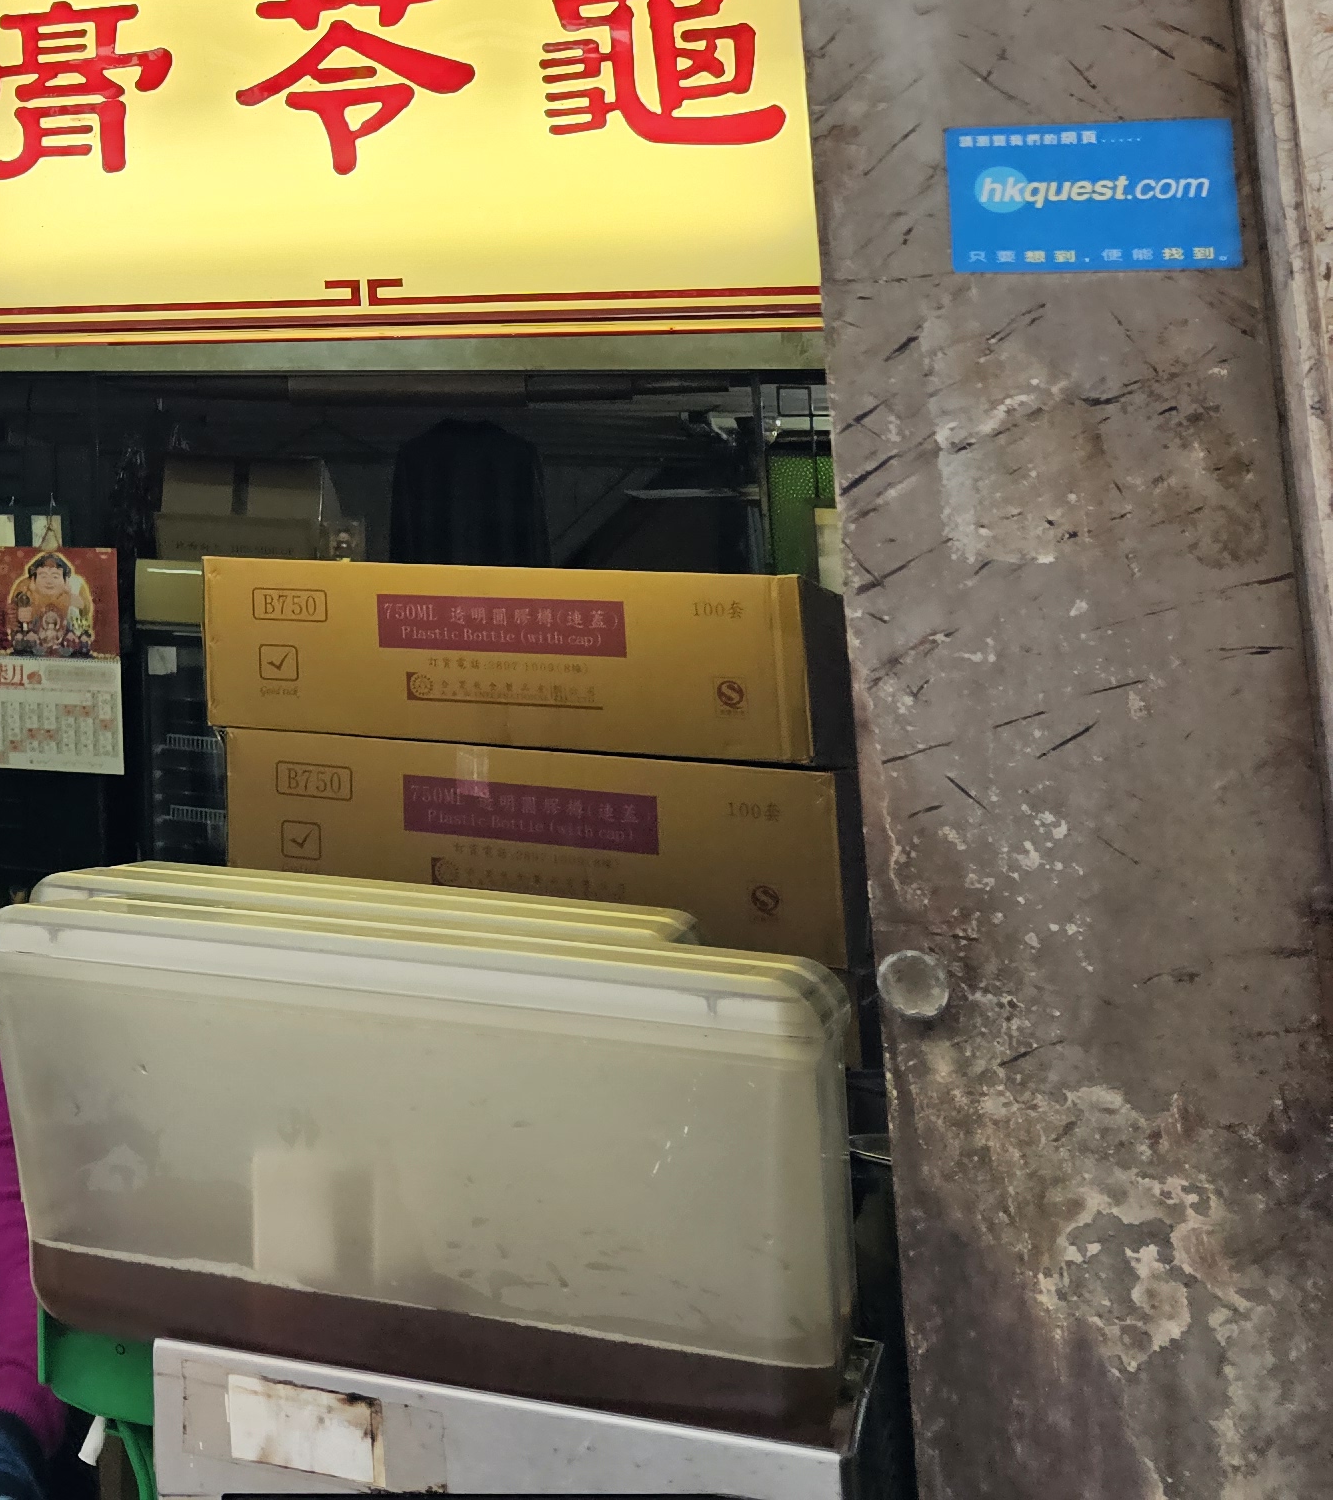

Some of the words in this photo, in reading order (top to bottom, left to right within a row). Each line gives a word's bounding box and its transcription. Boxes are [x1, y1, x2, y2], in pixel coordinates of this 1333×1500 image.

[980, 175, 1210, 208] hkquest.com
[262, 593, 318, 617] B750
[383, 602, 437, 622] 750ML
[692, 600, 744, 620] 100套
[400, 625, 459, 642] Plastic
[462, 628, 516, 644] Bottle
[519, 629, 563, 646] (with
[567, 633, 602, 648] cap)
[286, 767, 342, 794] B750
[410, 784, 466, 806] 750ML
[427, 810, 485, 828] Plastic
[490, 814, 544, 833] Bottle
[727, 800, 781, 822] 100套
